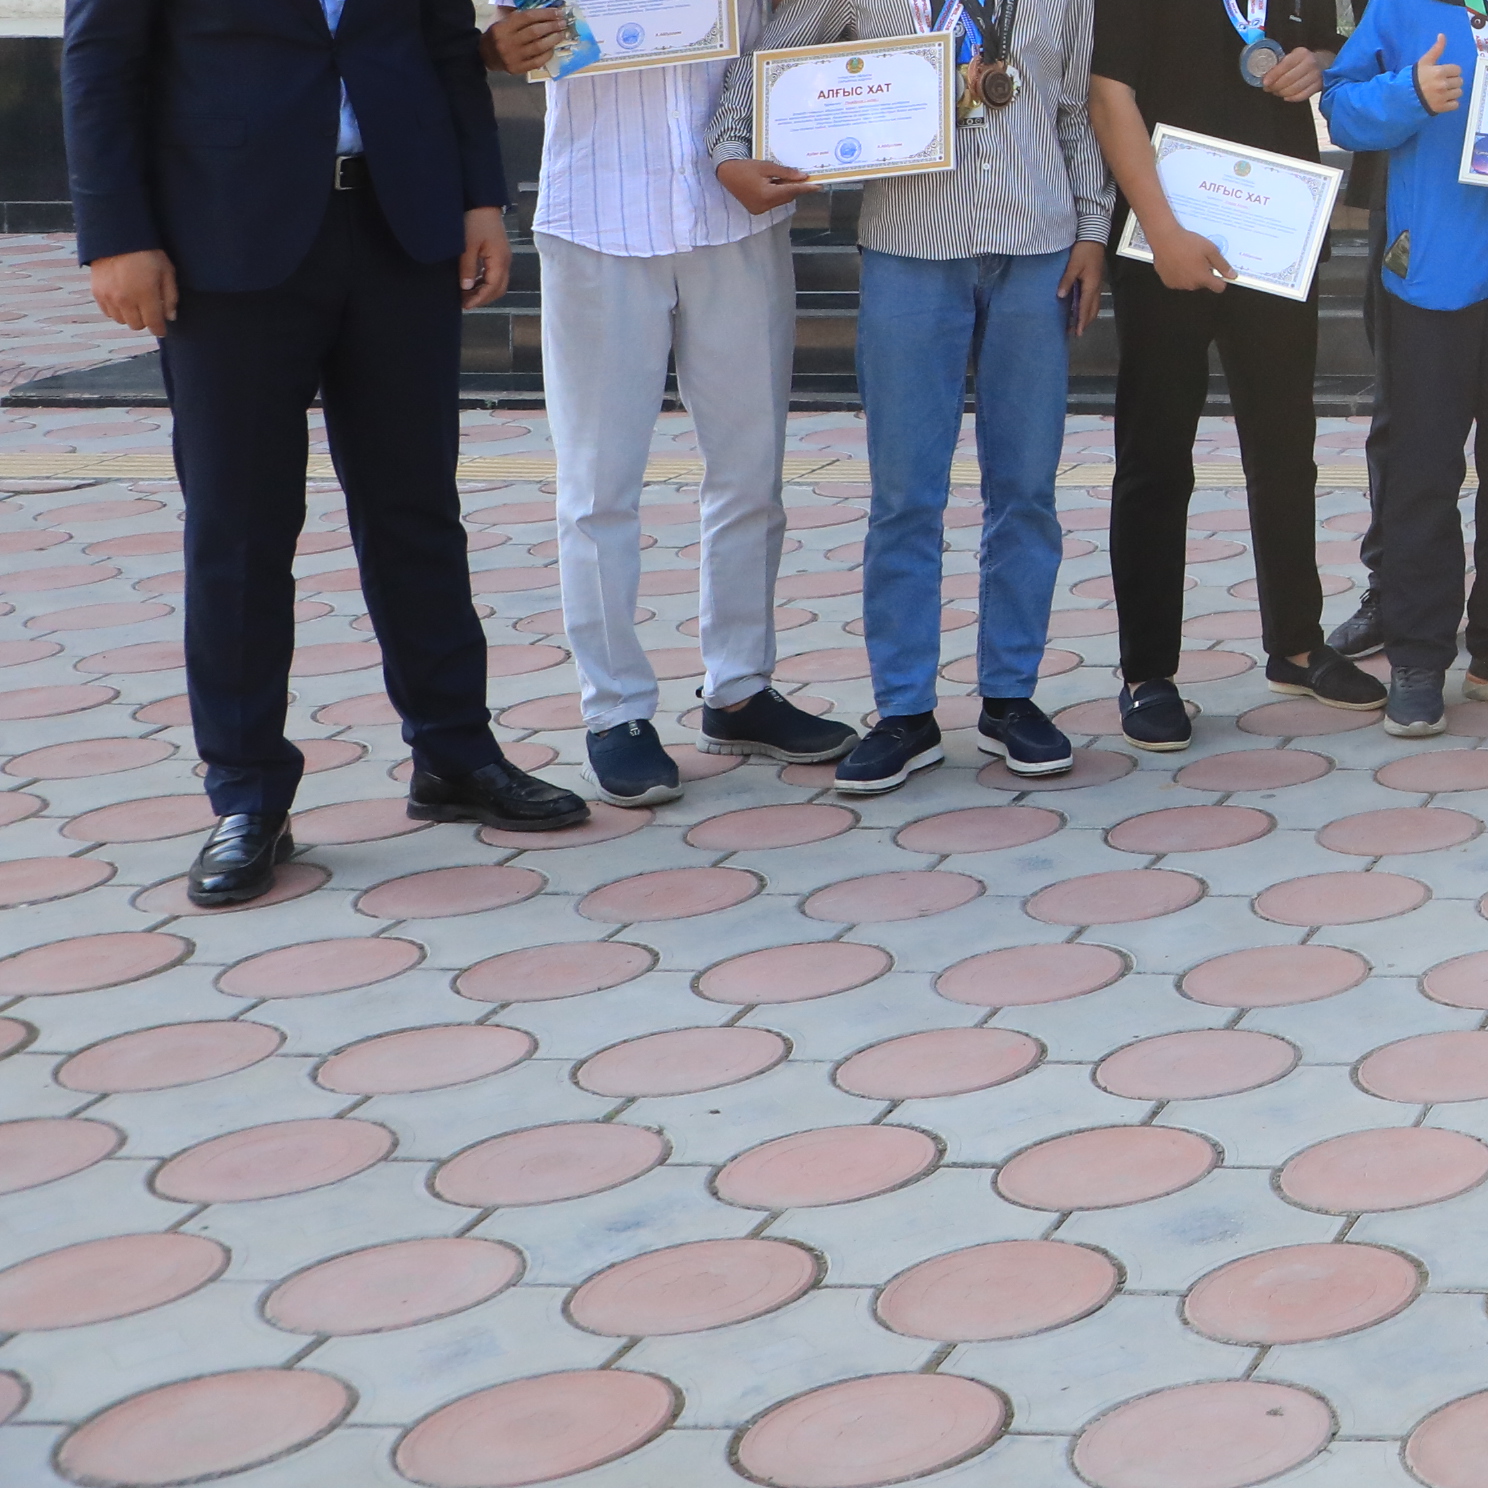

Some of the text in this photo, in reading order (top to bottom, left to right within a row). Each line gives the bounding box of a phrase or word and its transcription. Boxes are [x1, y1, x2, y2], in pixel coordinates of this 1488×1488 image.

[817, 83, 892, 99] АЛҒЫС ХАТ
[1199, 181, 1270, 206] АЛҒЫС ХАТ
